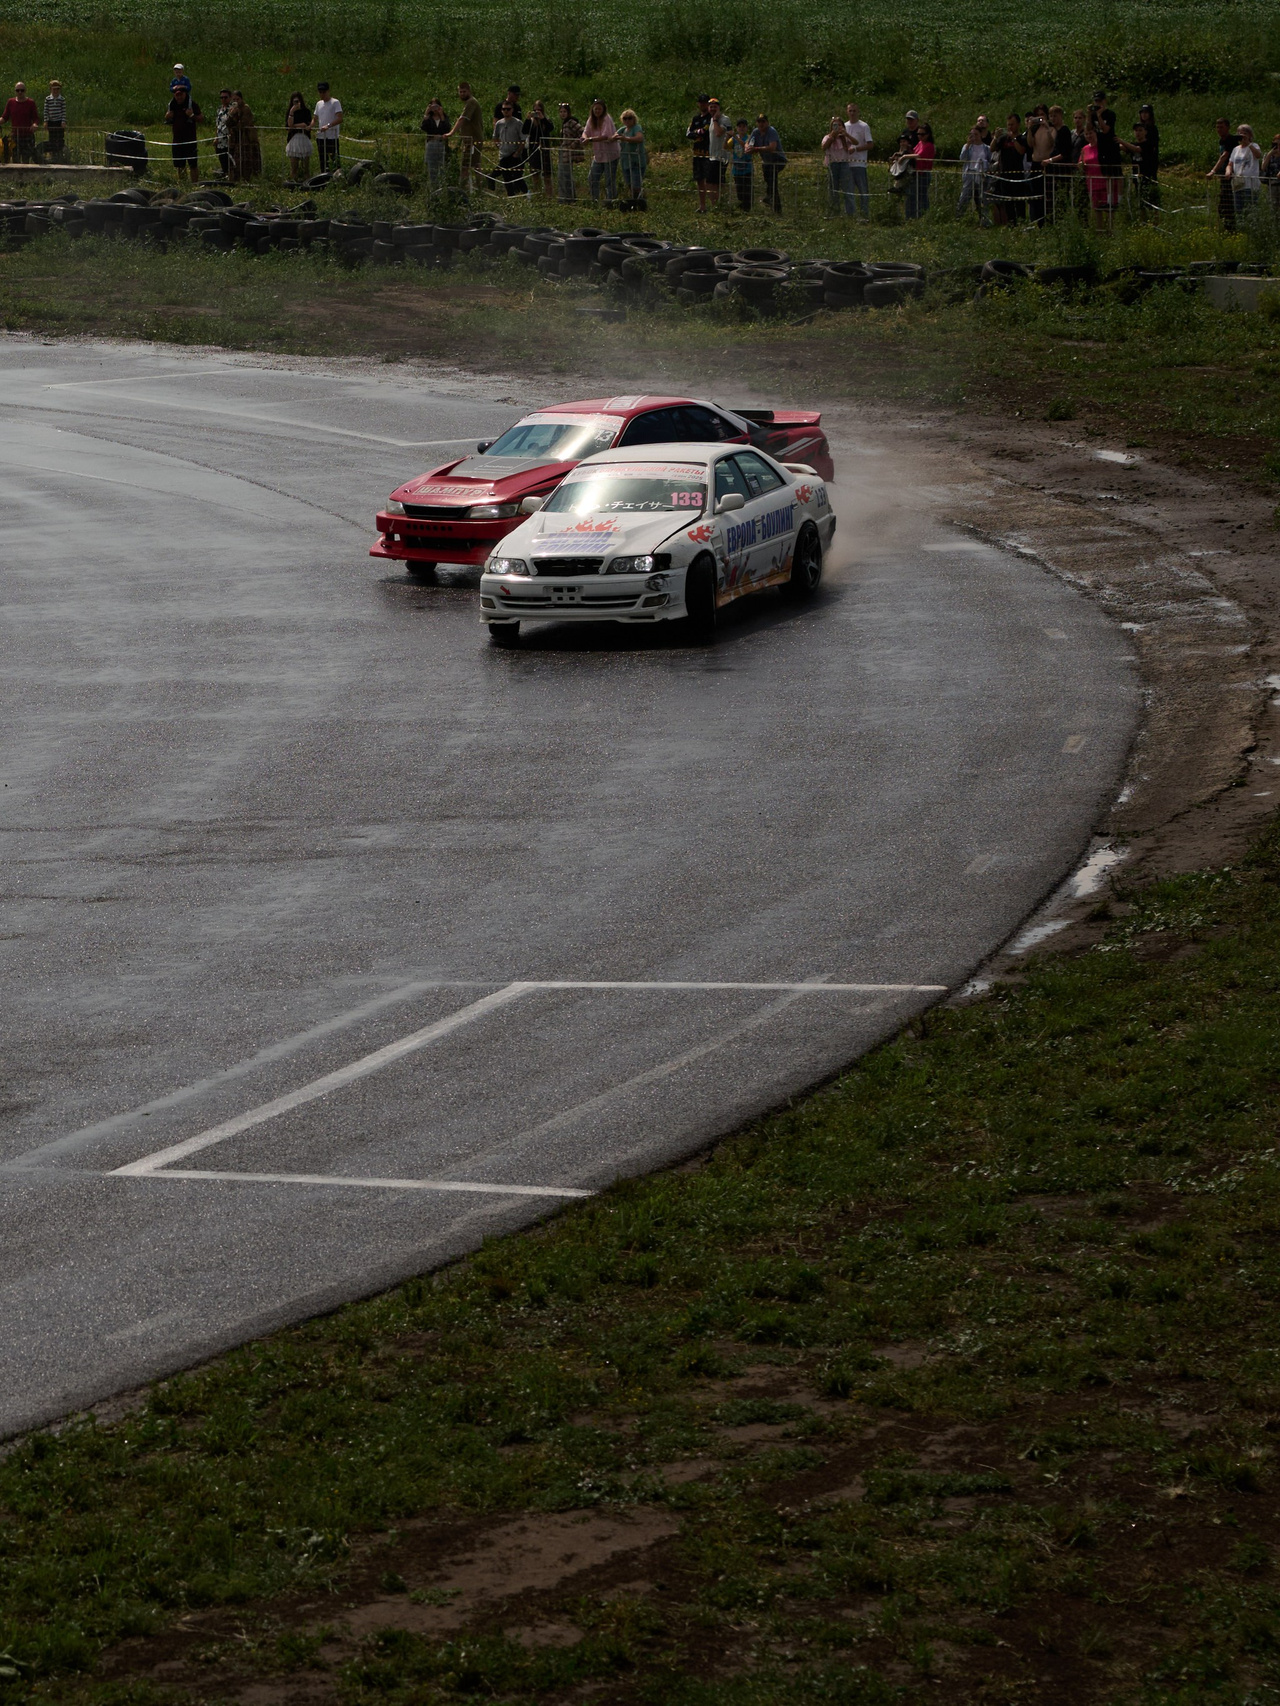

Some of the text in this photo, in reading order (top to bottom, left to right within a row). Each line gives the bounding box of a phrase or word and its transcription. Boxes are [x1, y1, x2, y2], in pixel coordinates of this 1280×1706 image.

[668, 467, 705, 475] РАКЕТЫ
[417, 486, 483, 497] ШАМПУР
[670, 492, 703, 506] 133
